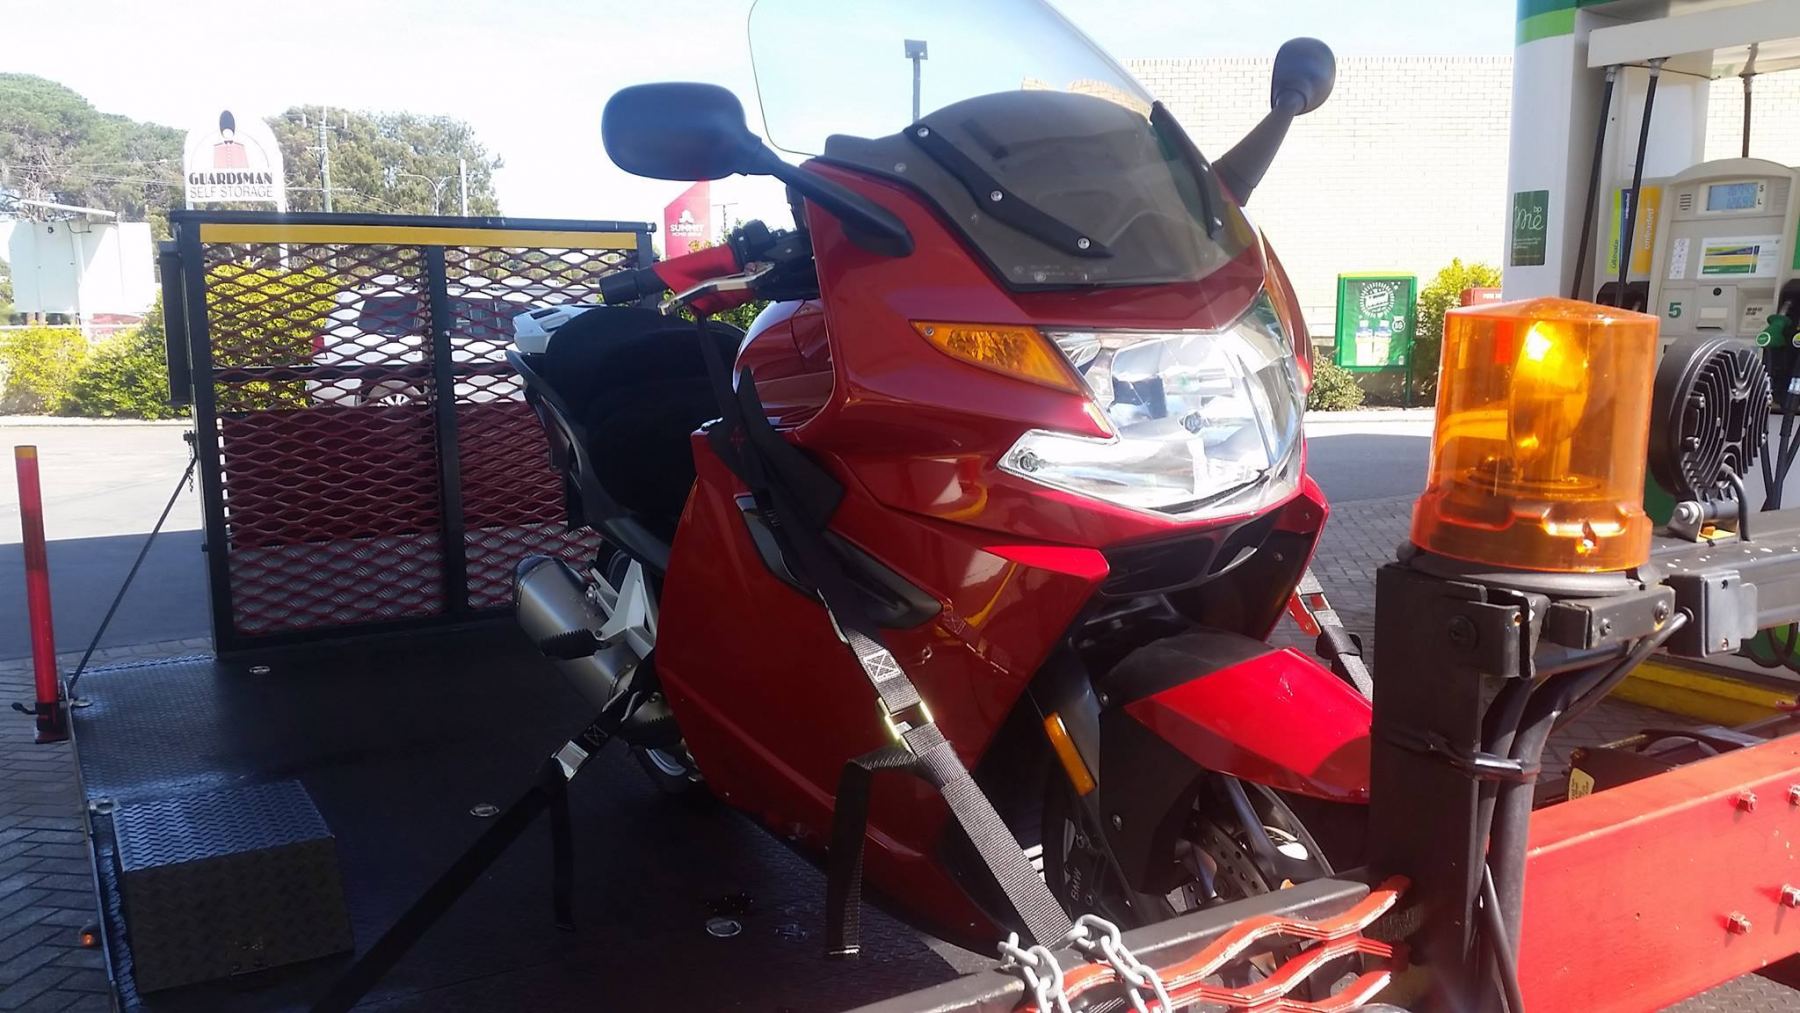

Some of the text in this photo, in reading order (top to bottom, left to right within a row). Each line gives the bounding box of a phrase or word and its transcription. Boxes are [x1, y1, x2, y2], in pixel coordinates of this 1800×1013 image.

[189, 172, 273, 185] GUARDSMAN
[190, 185, 273, 198] SELF STORAGE
[670, 224, 705, 232] SUMMIT
[1668, 302, 1682, 318] 5
[1071, 867, 1082, 901] BMW
